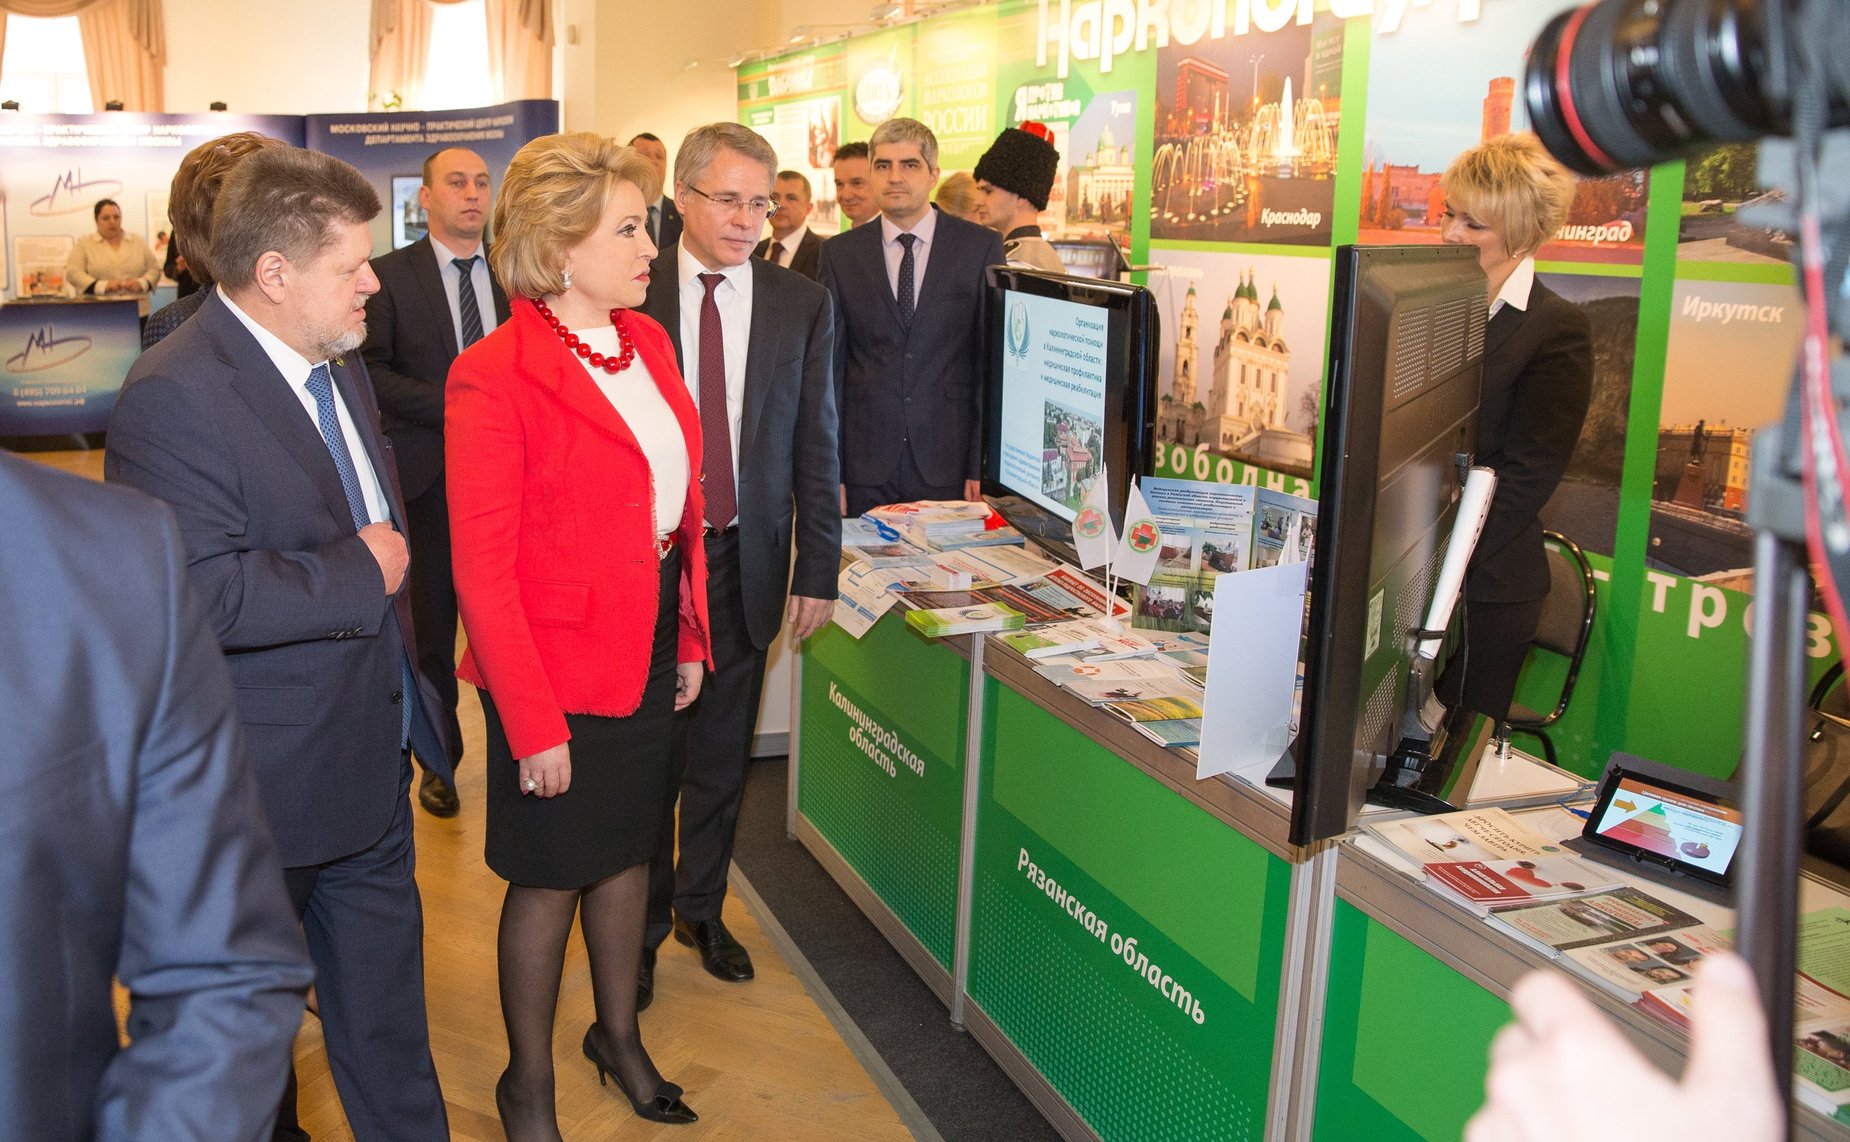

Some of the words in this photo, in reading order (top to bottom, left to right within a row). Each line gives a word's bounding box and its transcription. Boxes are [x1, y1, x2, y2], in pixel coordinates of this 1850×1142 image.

[1261, 208, 1322, 230] Краснодар
[1555, 220, 1633, 248] нинград
[1075, 316, 1104, 332] Организация
[1681, 294, 1786, 325] Иркутск
[1647, 571, 1833, 658] трз
[828, 681, 925, 777] Калининградская
[849, 726, 897, 778] область
[1017, 847, 1109, 943] Рязанская
[1110, 933, 1206, 1025] область
